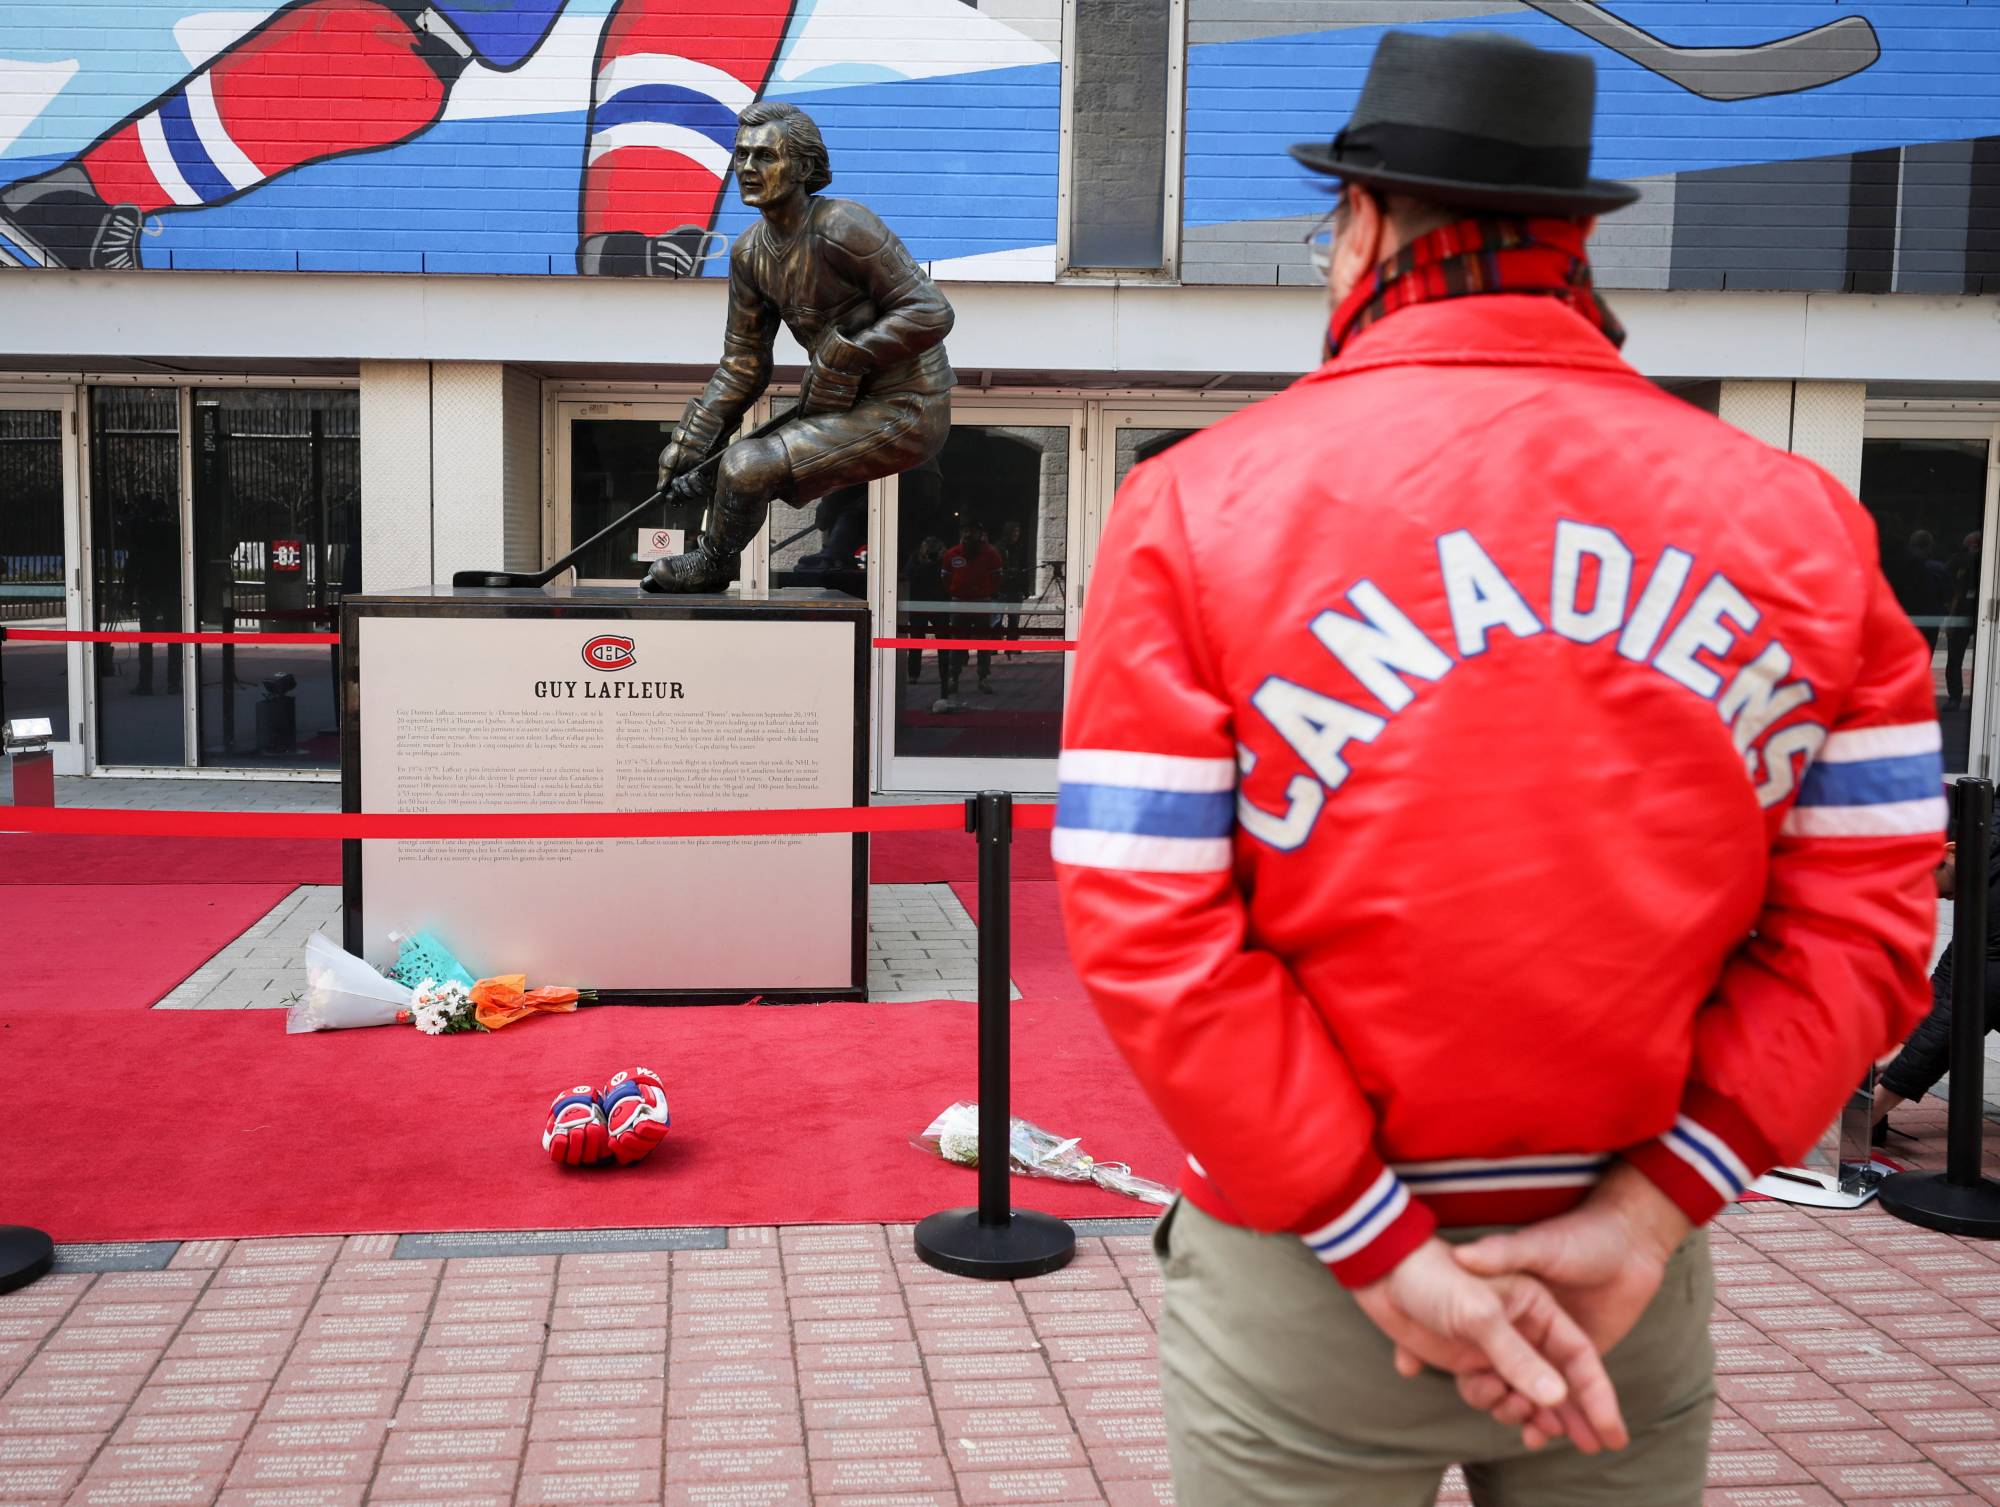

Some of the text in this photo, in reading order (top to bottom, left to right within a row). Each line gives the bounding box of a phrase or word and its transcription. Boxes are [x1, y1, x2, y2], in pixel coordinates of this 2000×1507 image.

[535, 681, 685, 699] GUY LAFLEUR
[1235, 519, 1826, 852] CANADIENS
